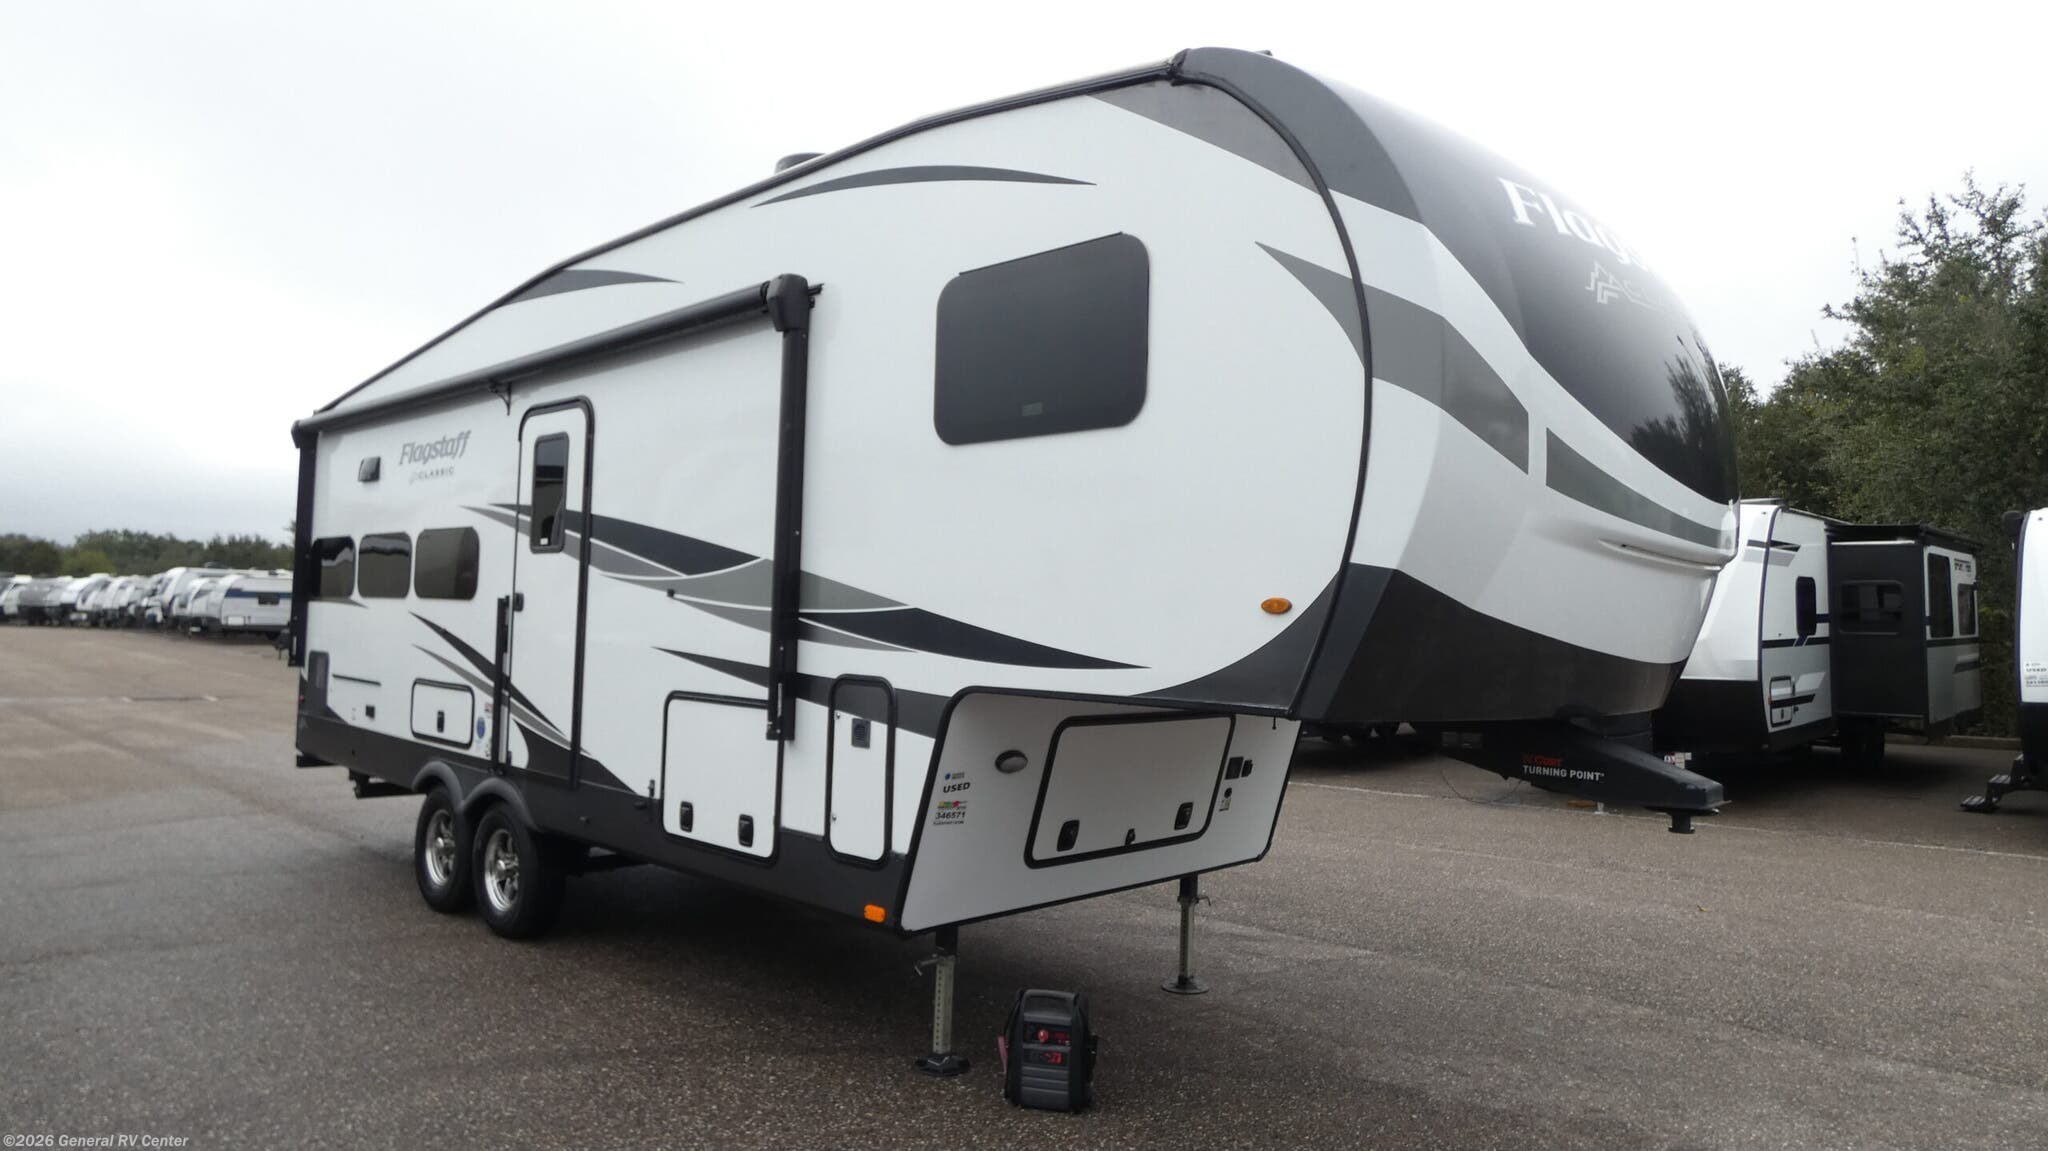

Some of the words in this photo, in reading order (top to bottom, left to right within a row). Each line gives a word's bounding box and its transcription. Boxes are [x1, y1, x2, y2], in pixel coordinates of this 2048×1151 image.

[399, 430, 471, 465] Flagstaff
[418, 466, 454, 479] CLASSIC
[1523, 765, 1567, 777] TURNING
[1570, 770, 1601, 781] POINT
[943, 782, 971, 793] USED
[936, 811, 966, 819] 346571
